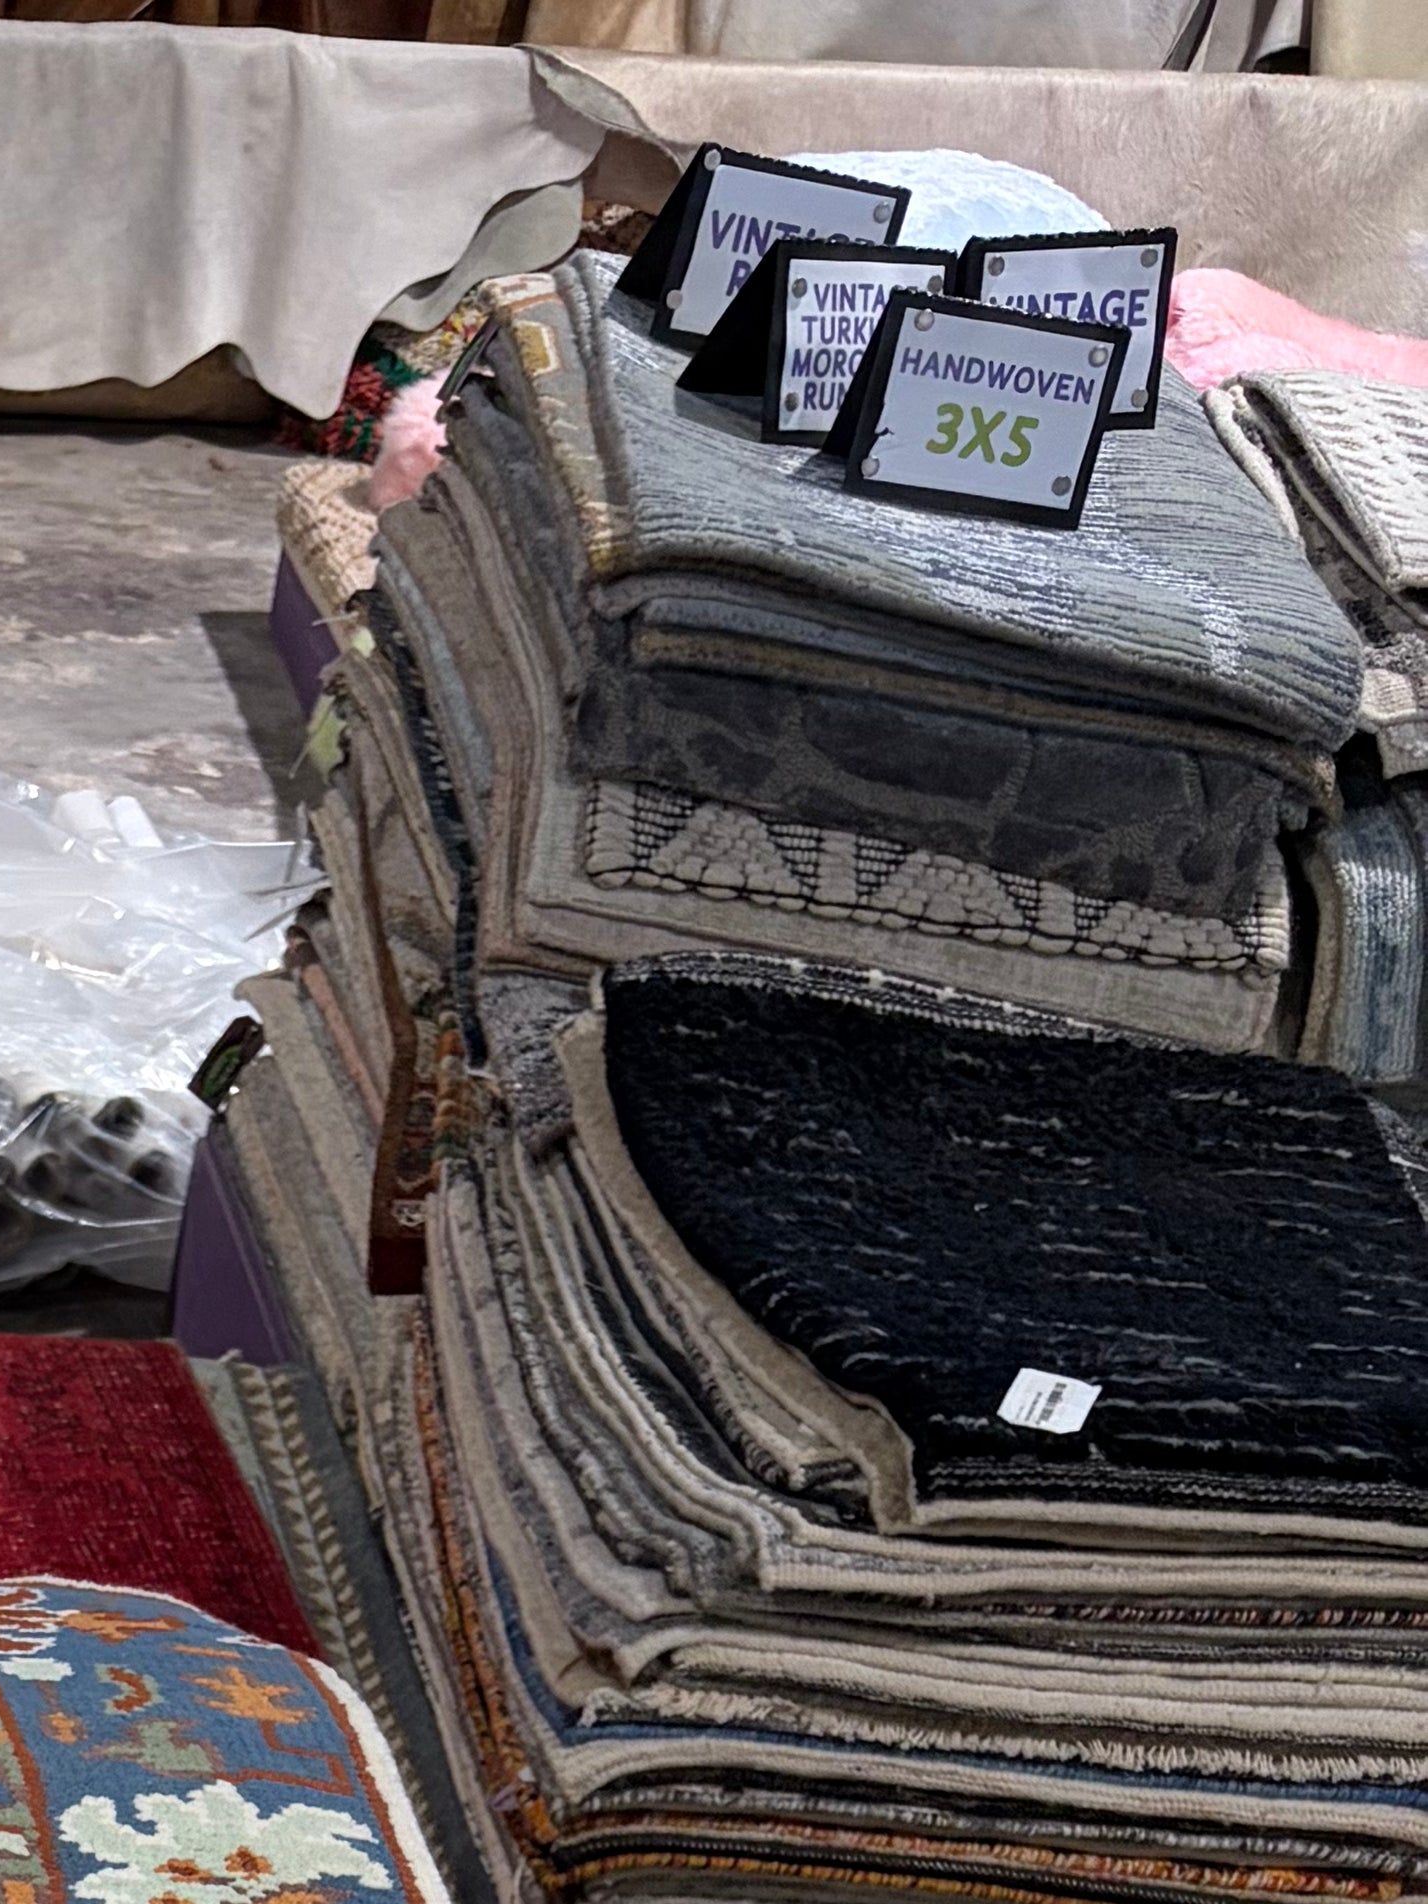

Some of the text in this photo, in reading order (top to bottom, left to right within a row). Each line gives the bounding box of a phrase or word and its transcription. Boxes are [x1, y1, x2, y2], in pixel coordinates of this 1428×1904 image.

[814, 283, 918, 313] VINTA
[899, 347, 1096, 405] HANDWOVEN
[925, 402, 1040, 468] 3X5
